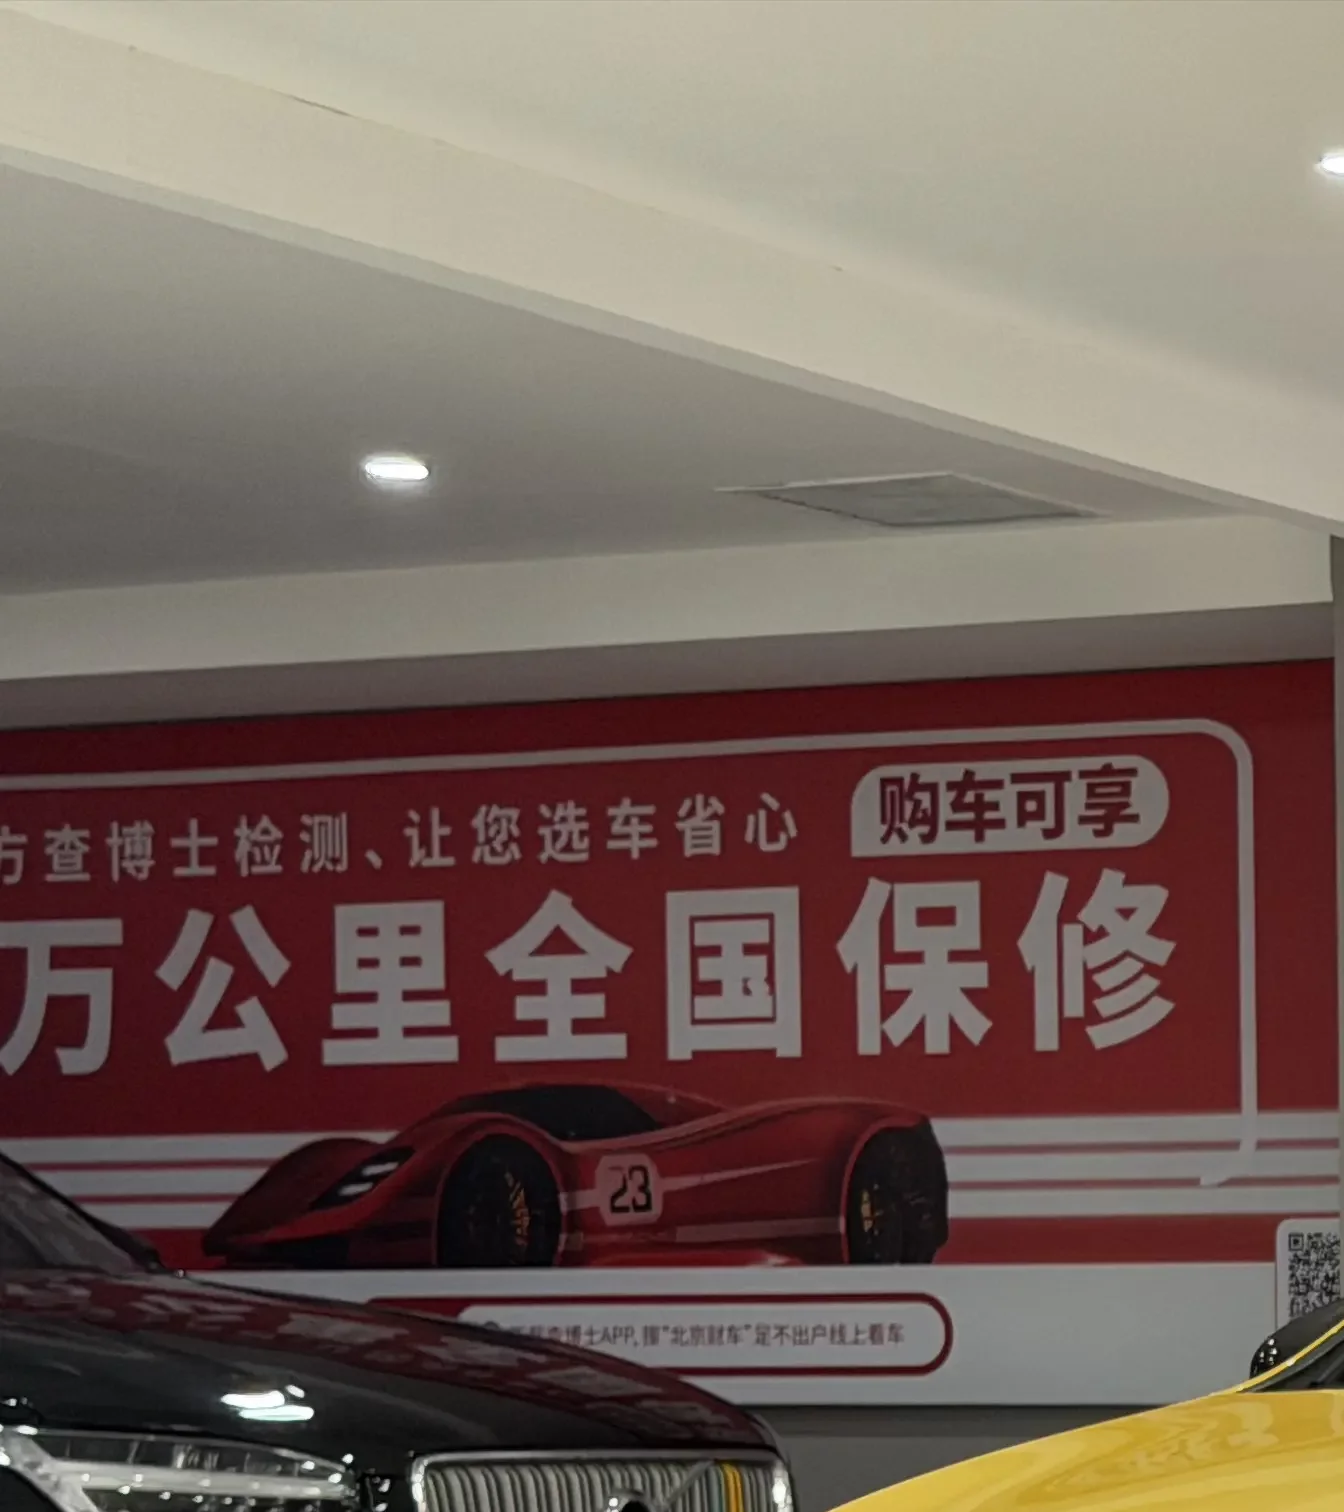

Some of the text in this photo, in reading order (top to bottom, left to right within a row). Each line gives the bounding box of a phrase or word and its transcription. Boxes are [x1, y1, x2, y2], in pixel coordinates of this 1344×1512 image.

[878, 762, 1141, 846] 购车可享
[0, 868, 1177, 1077] 万公里全国保修
[609, 1164, 654, 1214] 23
